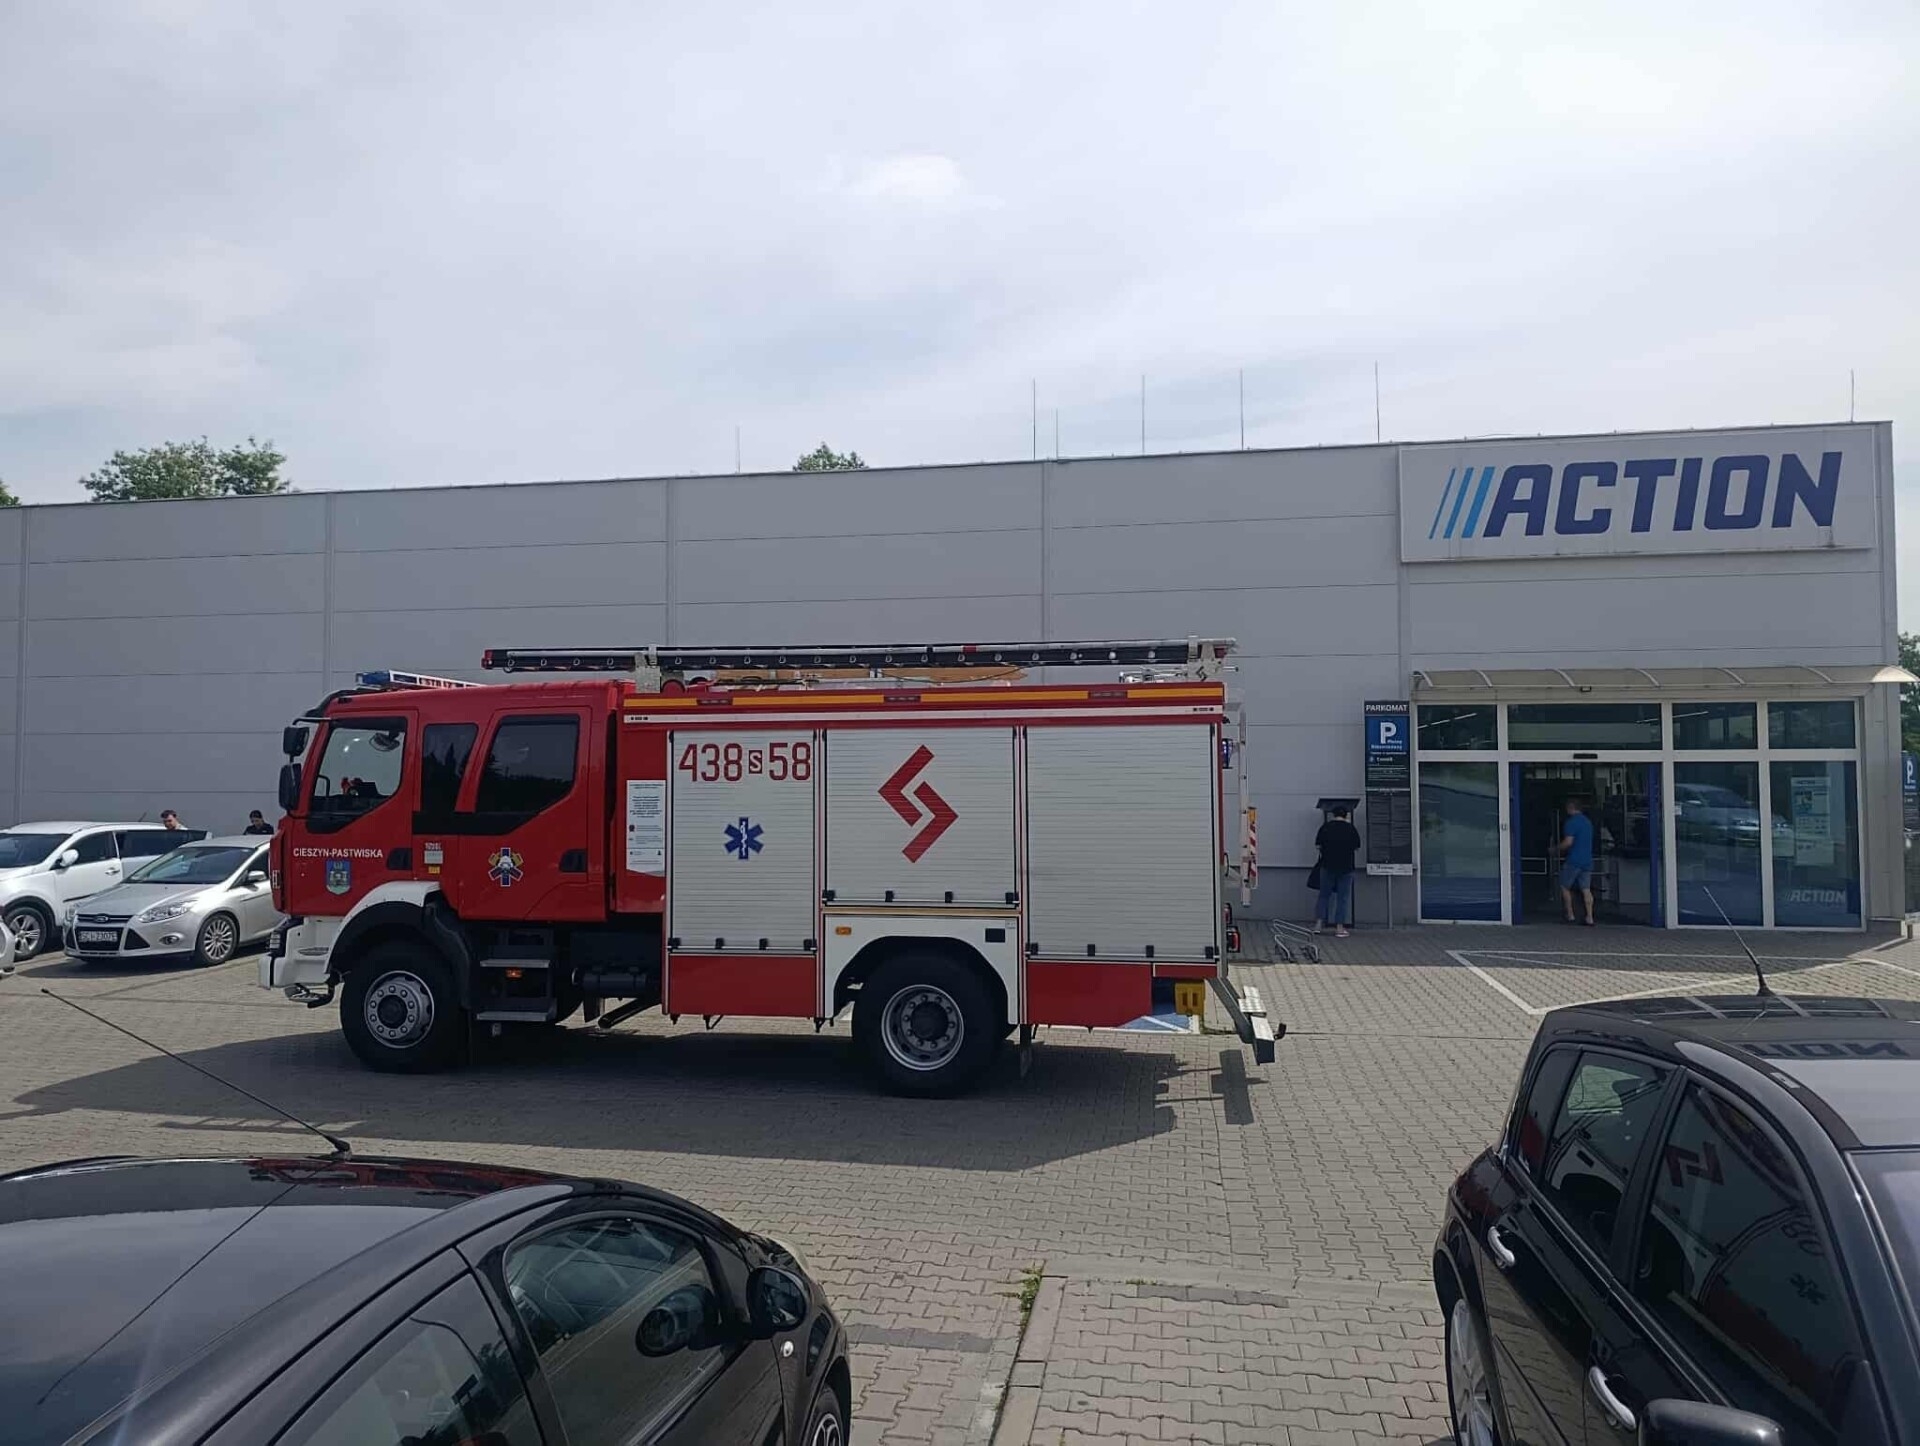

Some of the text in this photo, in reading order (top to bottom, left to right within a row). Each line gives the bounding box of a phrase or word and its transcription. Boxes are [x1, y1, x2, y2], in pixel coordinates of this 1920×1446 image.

[1483, 451, 1843, 538] ACTION
[1365, 704, 1408, 712] PARKOMAT
[1380, 721, 1397, 745] P
[678, 742, 811, 782] 438 S 58
[293, 847, 384, 859] CIESZYN-PASTWISKA
[1790, 889, 1846, 904] ACTION
